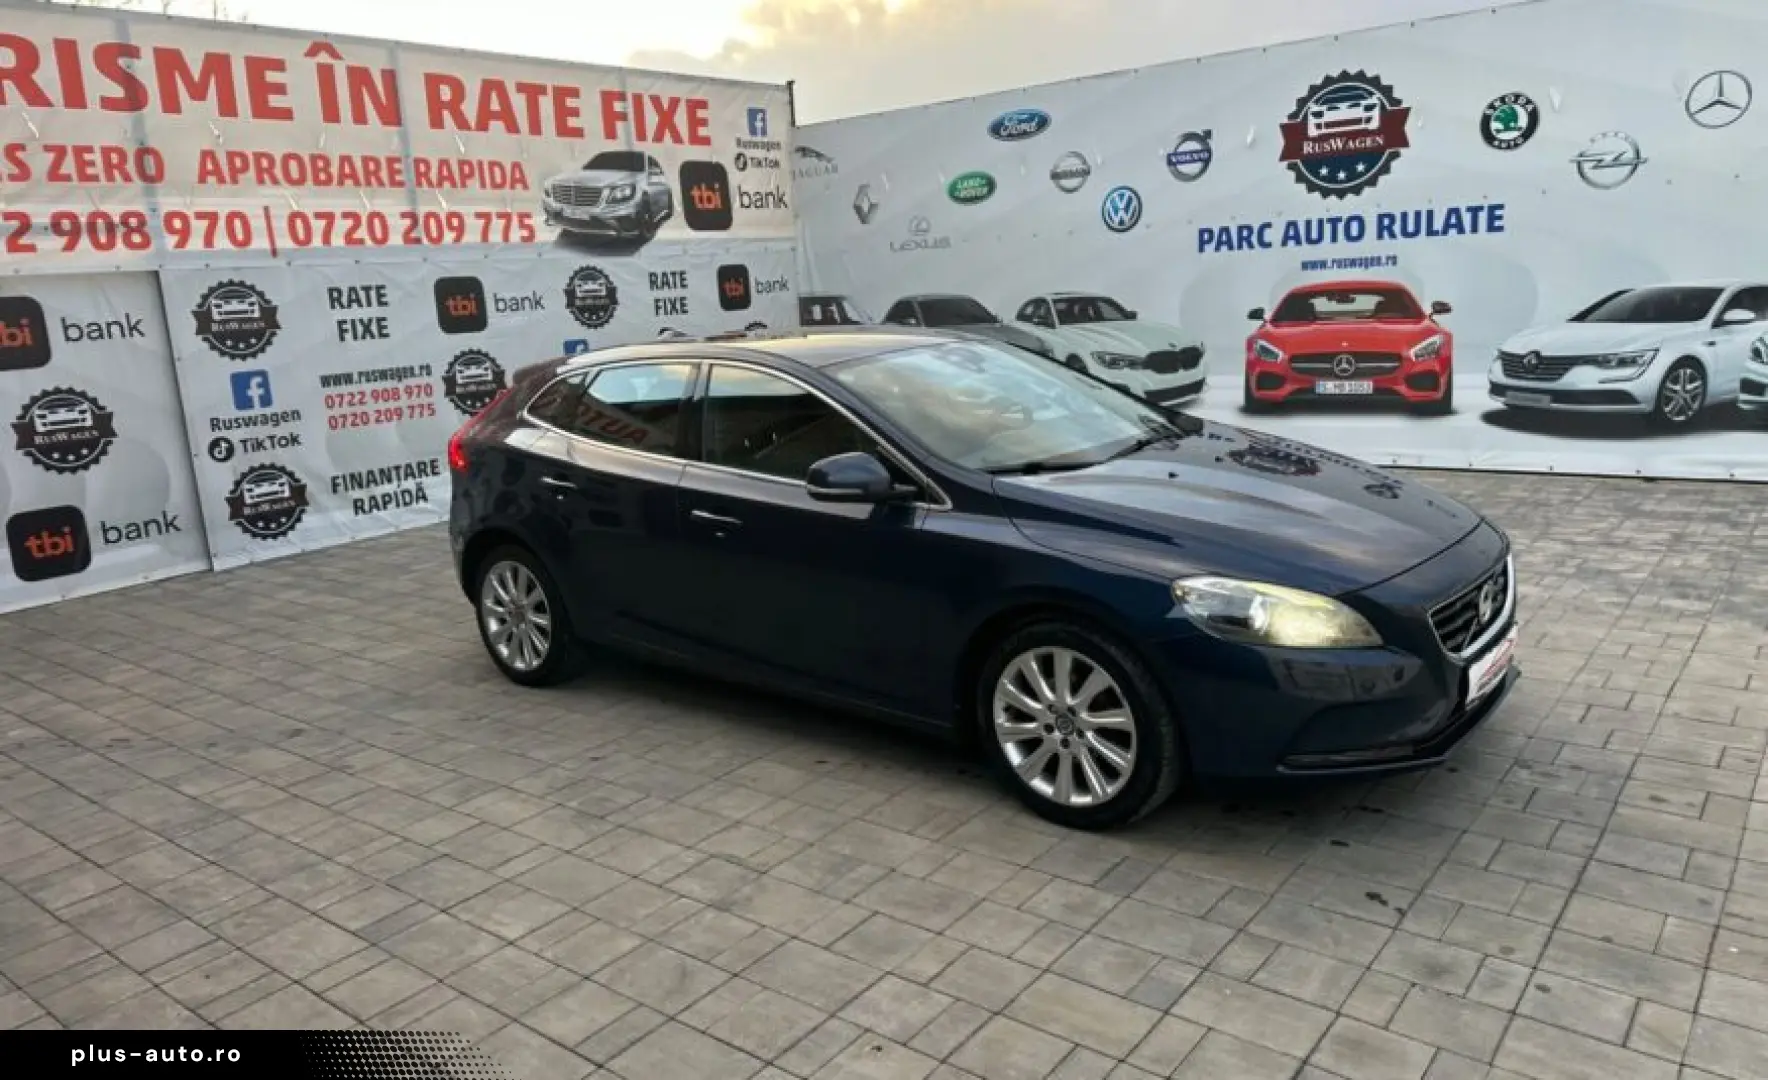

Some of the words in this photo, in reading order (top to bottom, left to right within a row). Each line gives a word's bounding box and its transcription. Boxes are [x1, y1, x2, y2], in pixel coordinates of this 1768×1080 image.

[0, 33, 293, 121] RISME
[303, 41, 403, 127] ÎN
[423, 72, 585, 139] RATE
[600, 89, 712, 147] FIXE
[43, 144, 165, 185] ZERO
[197, 149, 404, 188] APROBARE
[413, 157, 529, 191] RAPIDA
[690, 184, 720, 210] tbi
[738, 185, 789, 211] bank
[51, 211, 152, 253] 908
[163, 210, 253, 249] 970
[287, 210, 389, 247] 0720
[399, 211, 465, 245] 209
[471, 211, 536, 243] 775
[1197, 221, 1273, 254] PARC
[1281, 213, 1366, 247] AUTO
[1376, 203, 1506, 241] RULATE
[1300, 253, 1398, 272] www.ruswagen.ro
[648, 269, 689, 292] RATE
[723, 277, 745, 299] tbi
[754, 275, 790, 295] bank
[326, 283, 389, 311] RATE
[444, 293, 478, 317] tbi
[493, 290, 546, 314] bank
[655, 296, 690, 317] FIXE
[60, 312, 146, 343] bank
[336, 316, 391, 343] FIXE
[319, 363, 433, 388] www.ruswagen.ro
[324, 389, 368, 410] 0722
[370, 387, 401, 405] 908
[404, 383, 434, 402] 970
[209, 408, 302, 433] Ruswagen
[328, 410, 370, 431] 0720
[374, 406, 403, 426] 209
[407, 402, 437, 422] 775
[239, 431, 303, 455] TikTok
[352, 485, 429, 517] RAPIDĂ
[24, 526, 75, 560] tbi
[100, 510, 183, 545] bank
